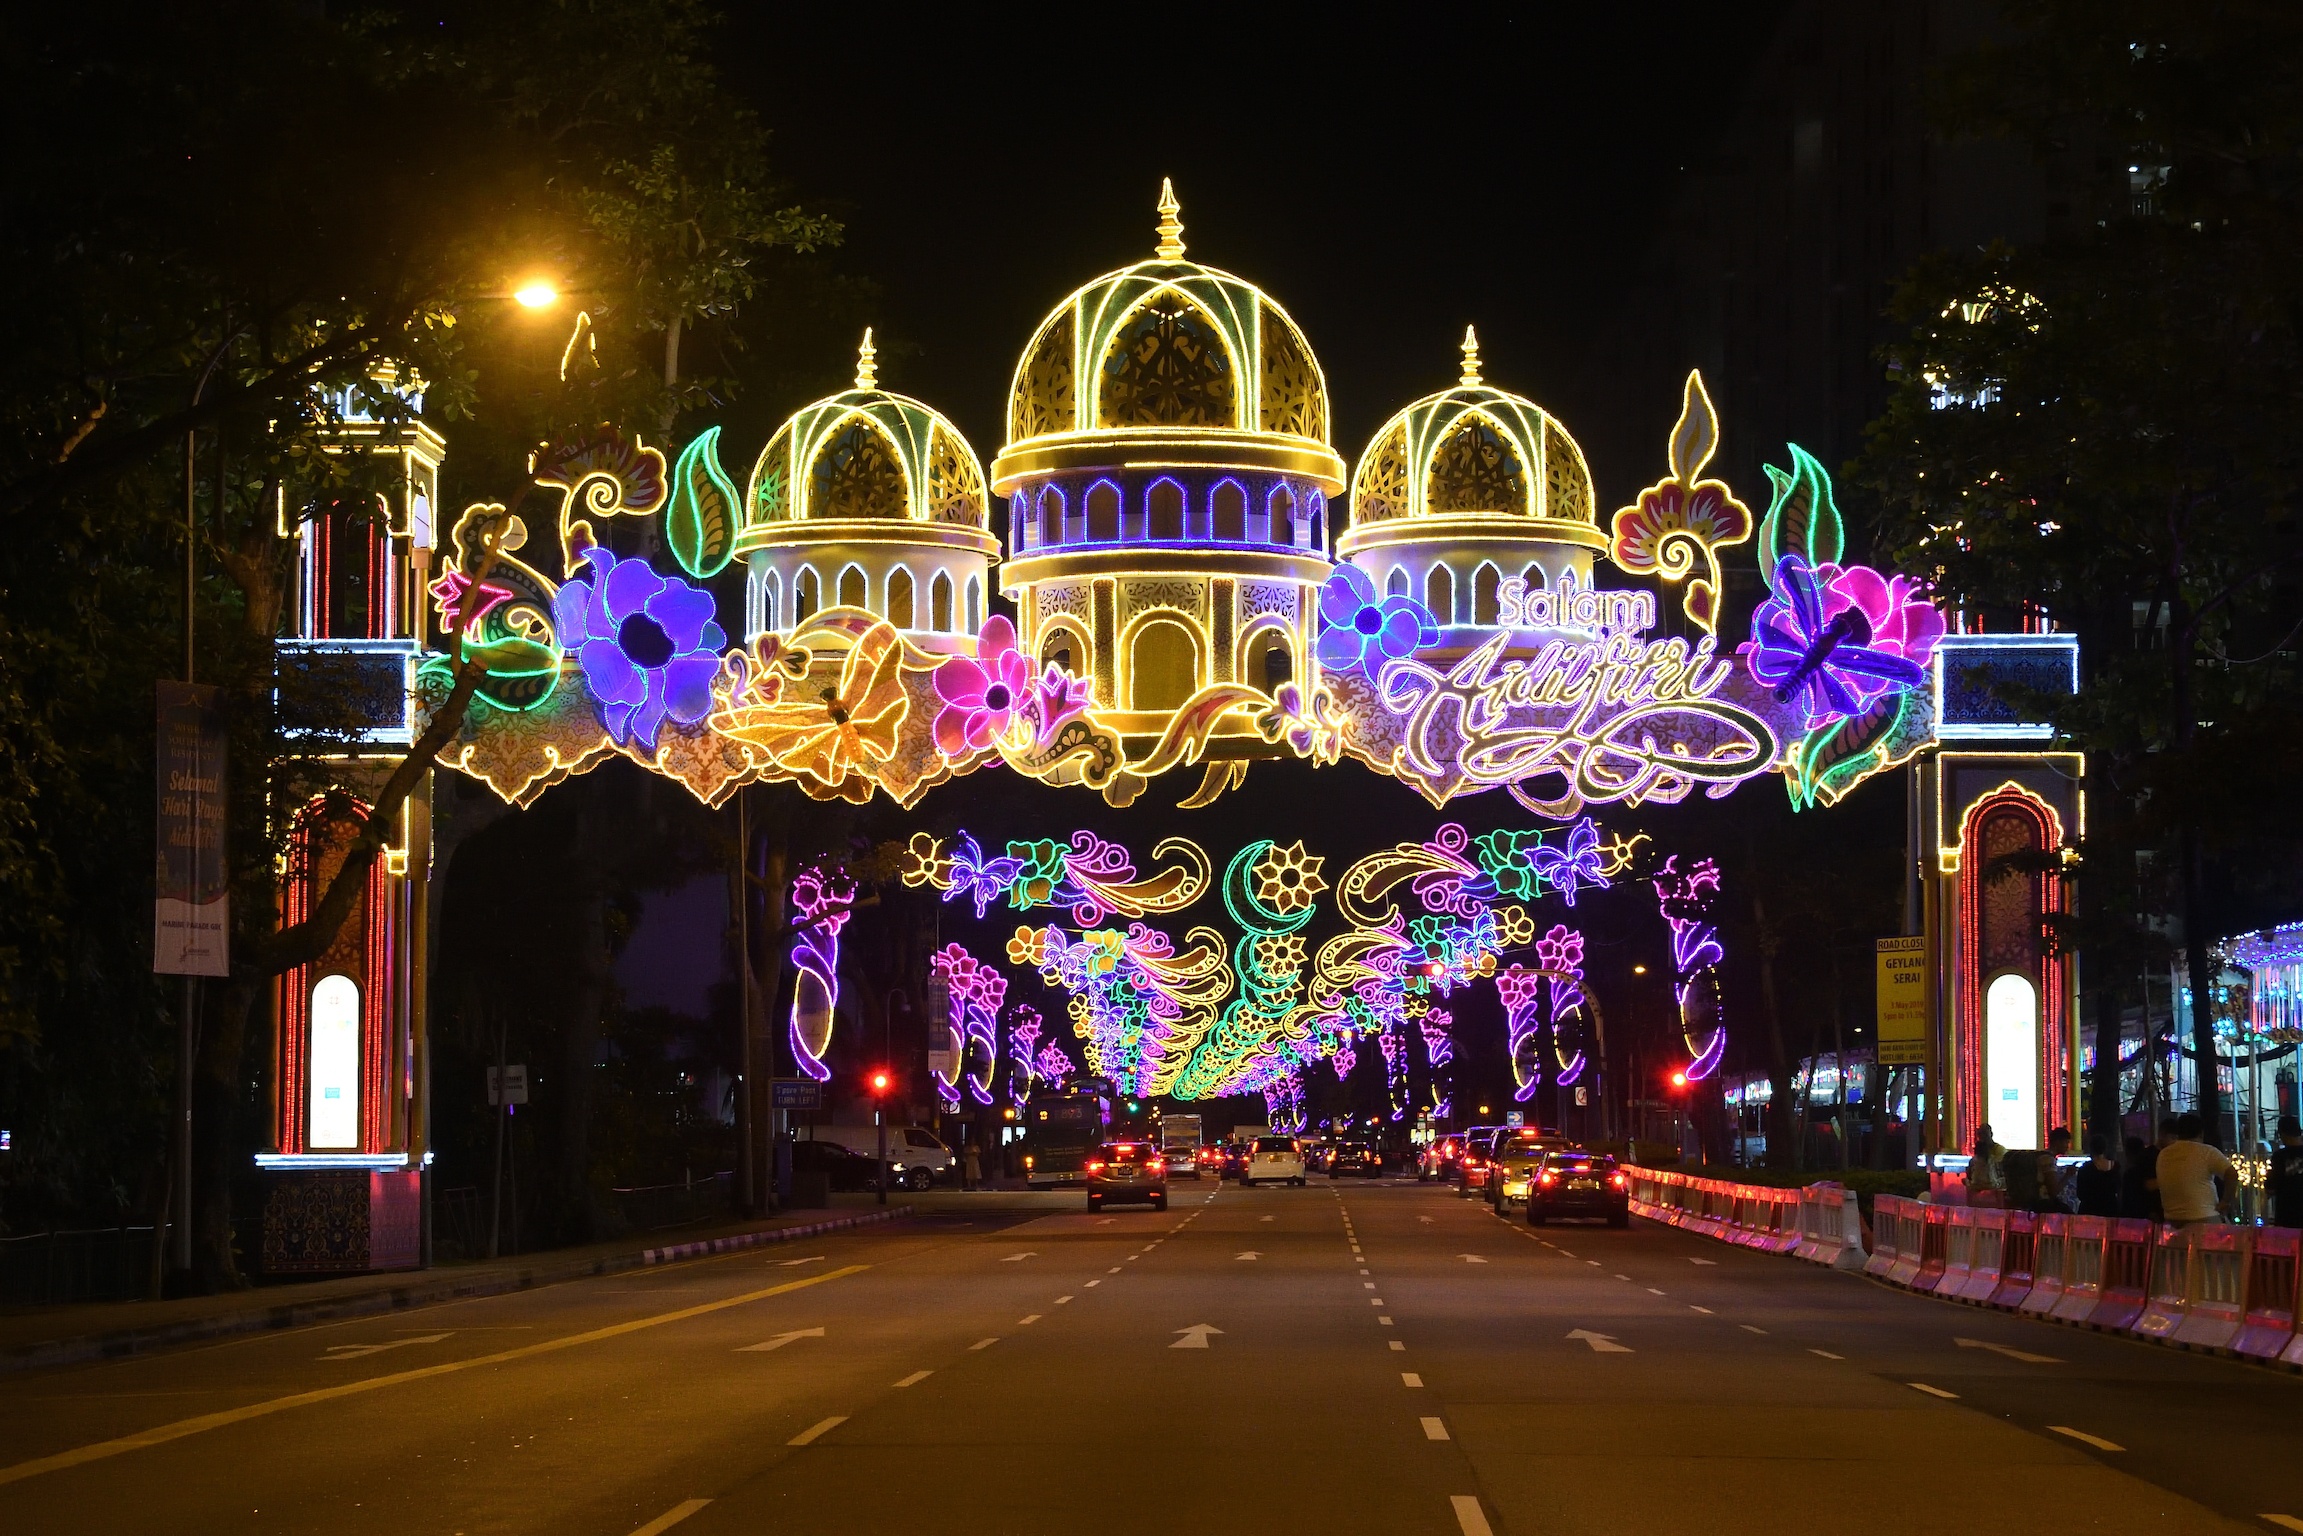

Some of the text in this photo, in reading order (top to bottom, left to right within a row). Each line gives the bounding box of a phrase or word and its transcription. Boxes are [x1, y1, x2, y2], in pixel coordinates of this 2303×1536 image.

[1496, 575, 1655, 628] Salam
[1377, 629, 1781, 804] Aidilfitri
[161, 797, 225, 824] Hari Raya
[1878, 940, 1899, 950] ROAD
[1894, 973, 1920, 984] SERAI
